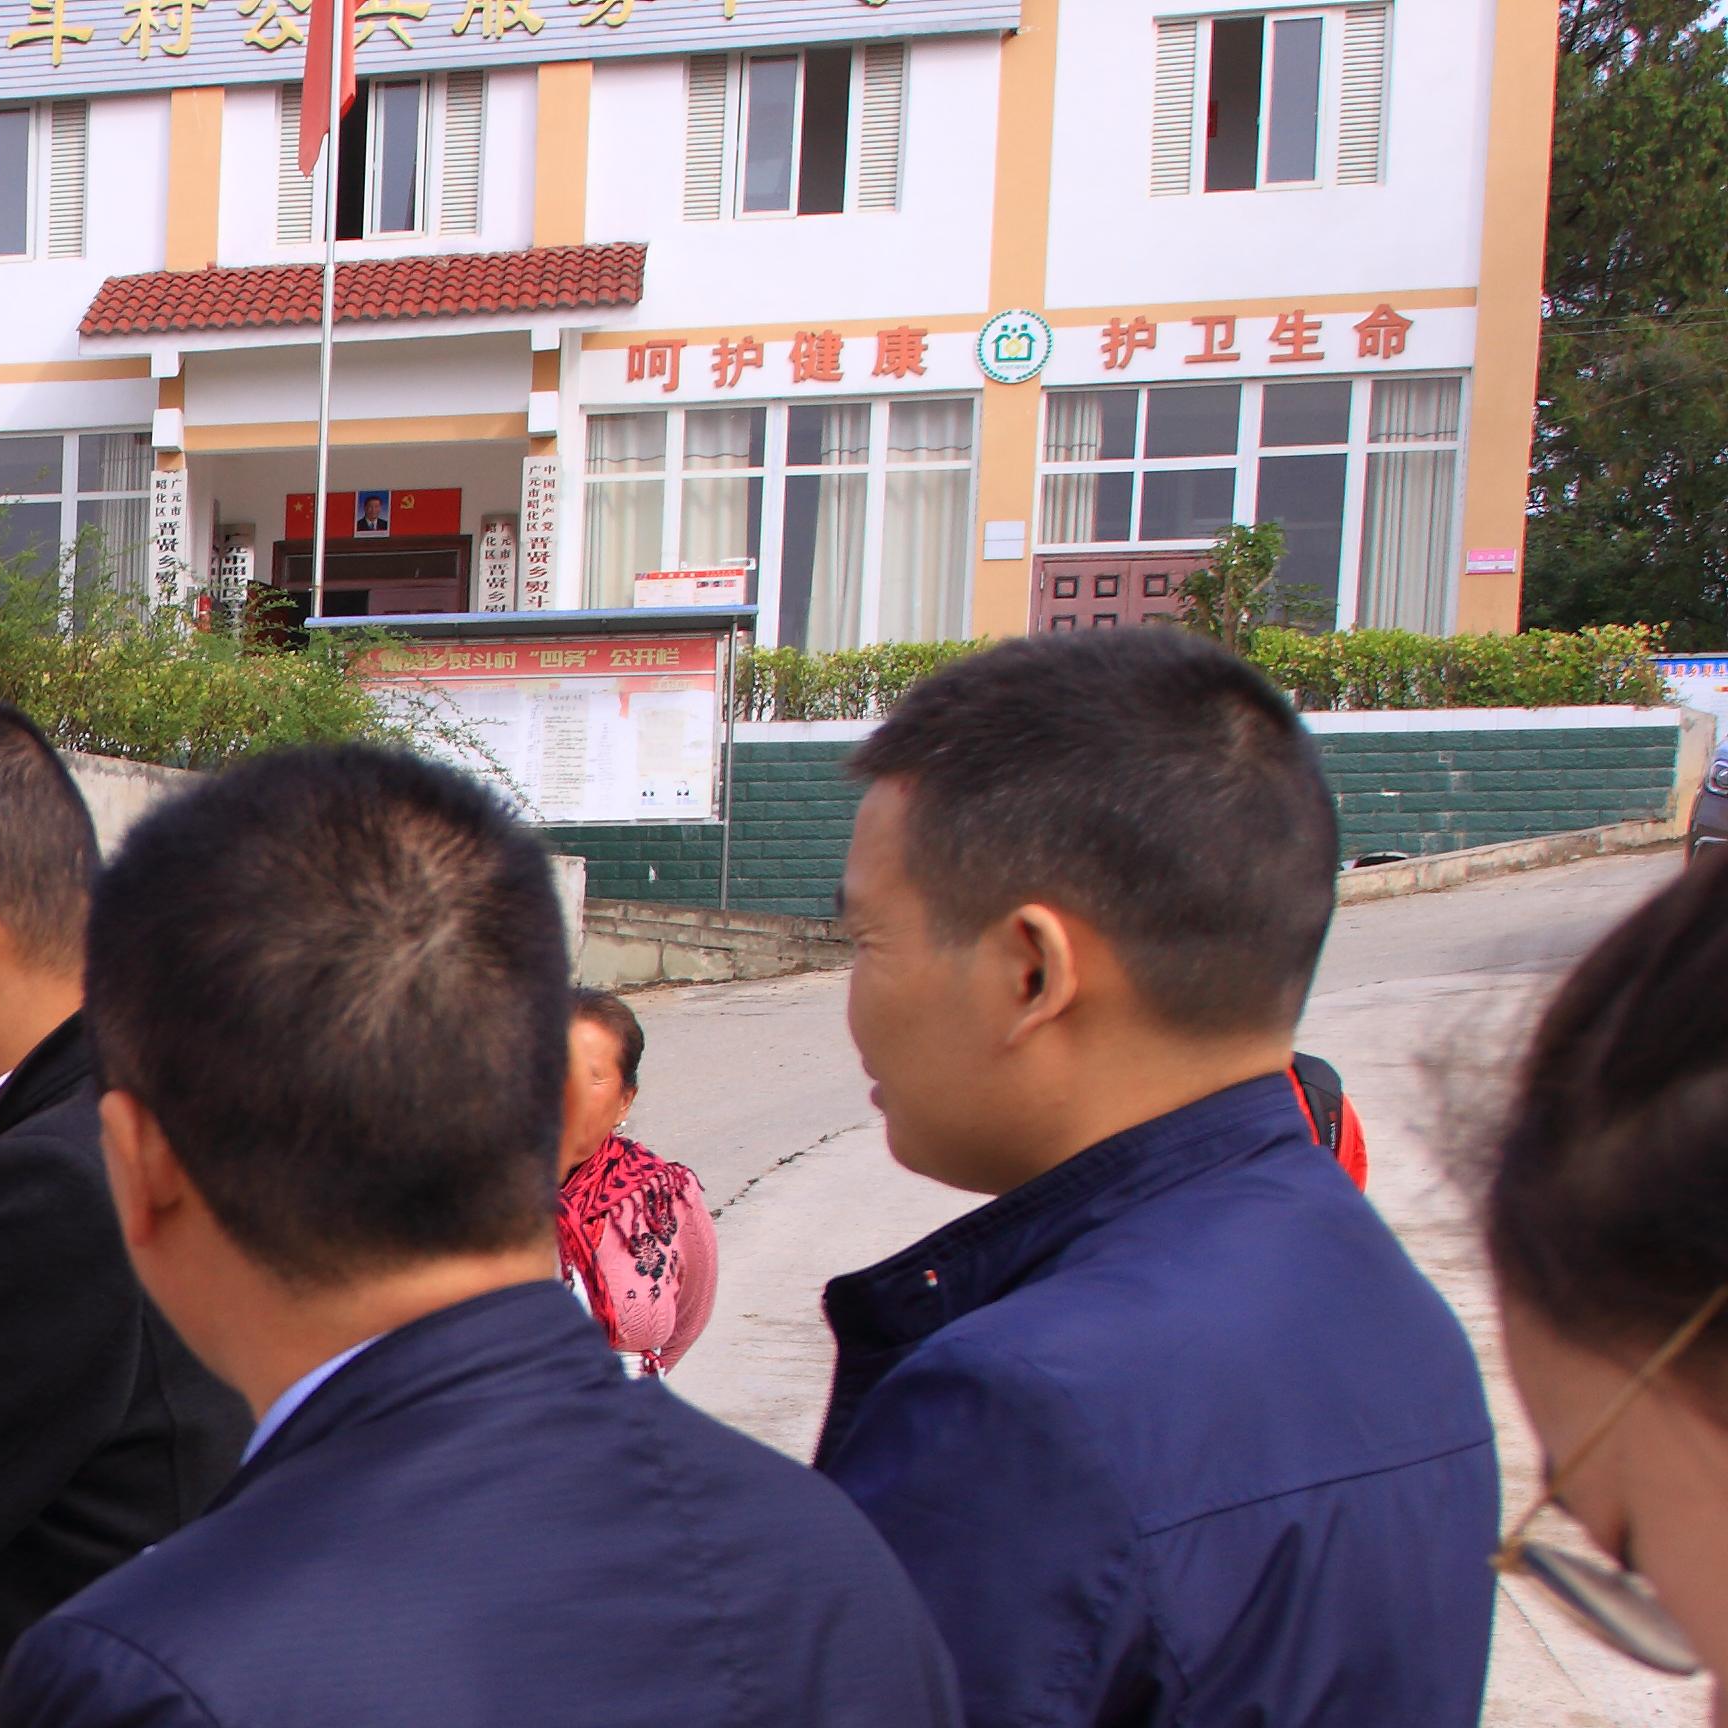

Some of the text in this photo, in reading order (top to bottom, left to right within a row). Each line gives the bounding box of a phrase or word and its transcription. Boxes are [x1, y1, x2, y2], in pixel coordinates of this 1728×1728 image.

[625, 303, 1416, 392] 呵护健康 护卫生命
[542, 464, 556, 532] 中国共产党
